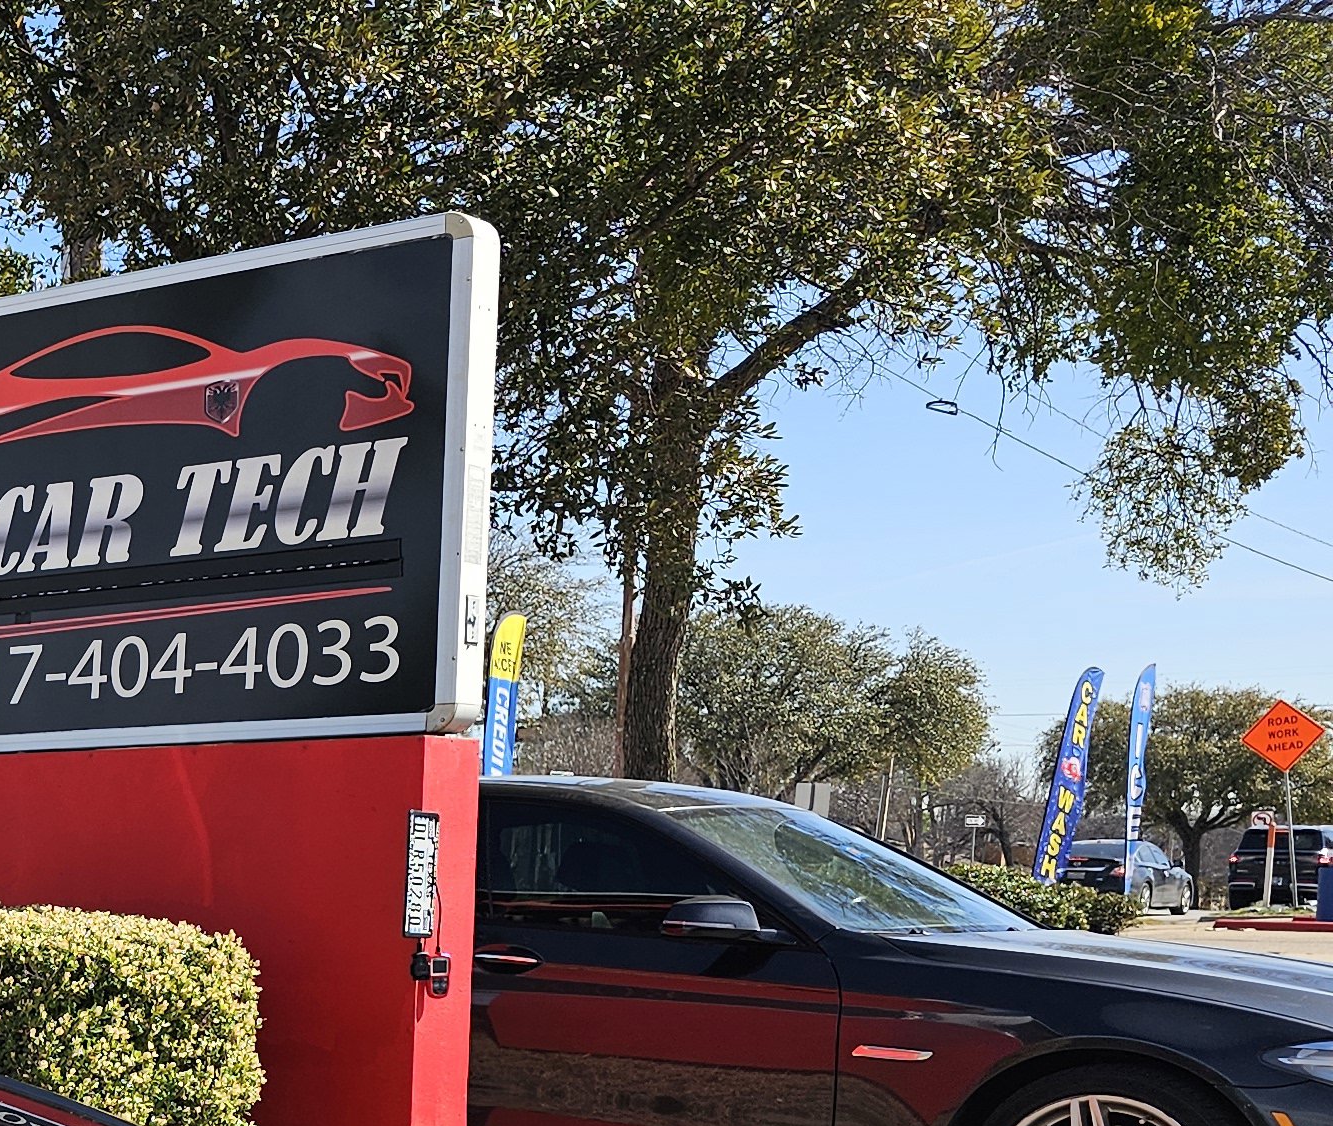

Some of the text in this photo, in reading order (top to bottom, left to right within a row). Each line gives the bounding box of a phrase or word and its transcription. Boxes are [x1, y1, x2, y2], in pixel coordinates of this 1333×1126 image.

[168, 436, 409, 558] TECH
[1267, 715, 1299, 727] ROAD
[1267, 728, 1299, 739] WORK
[1266, 740, 1304, 753] AHEAD
[1039, 680, 1094, 881] CAR WASH
